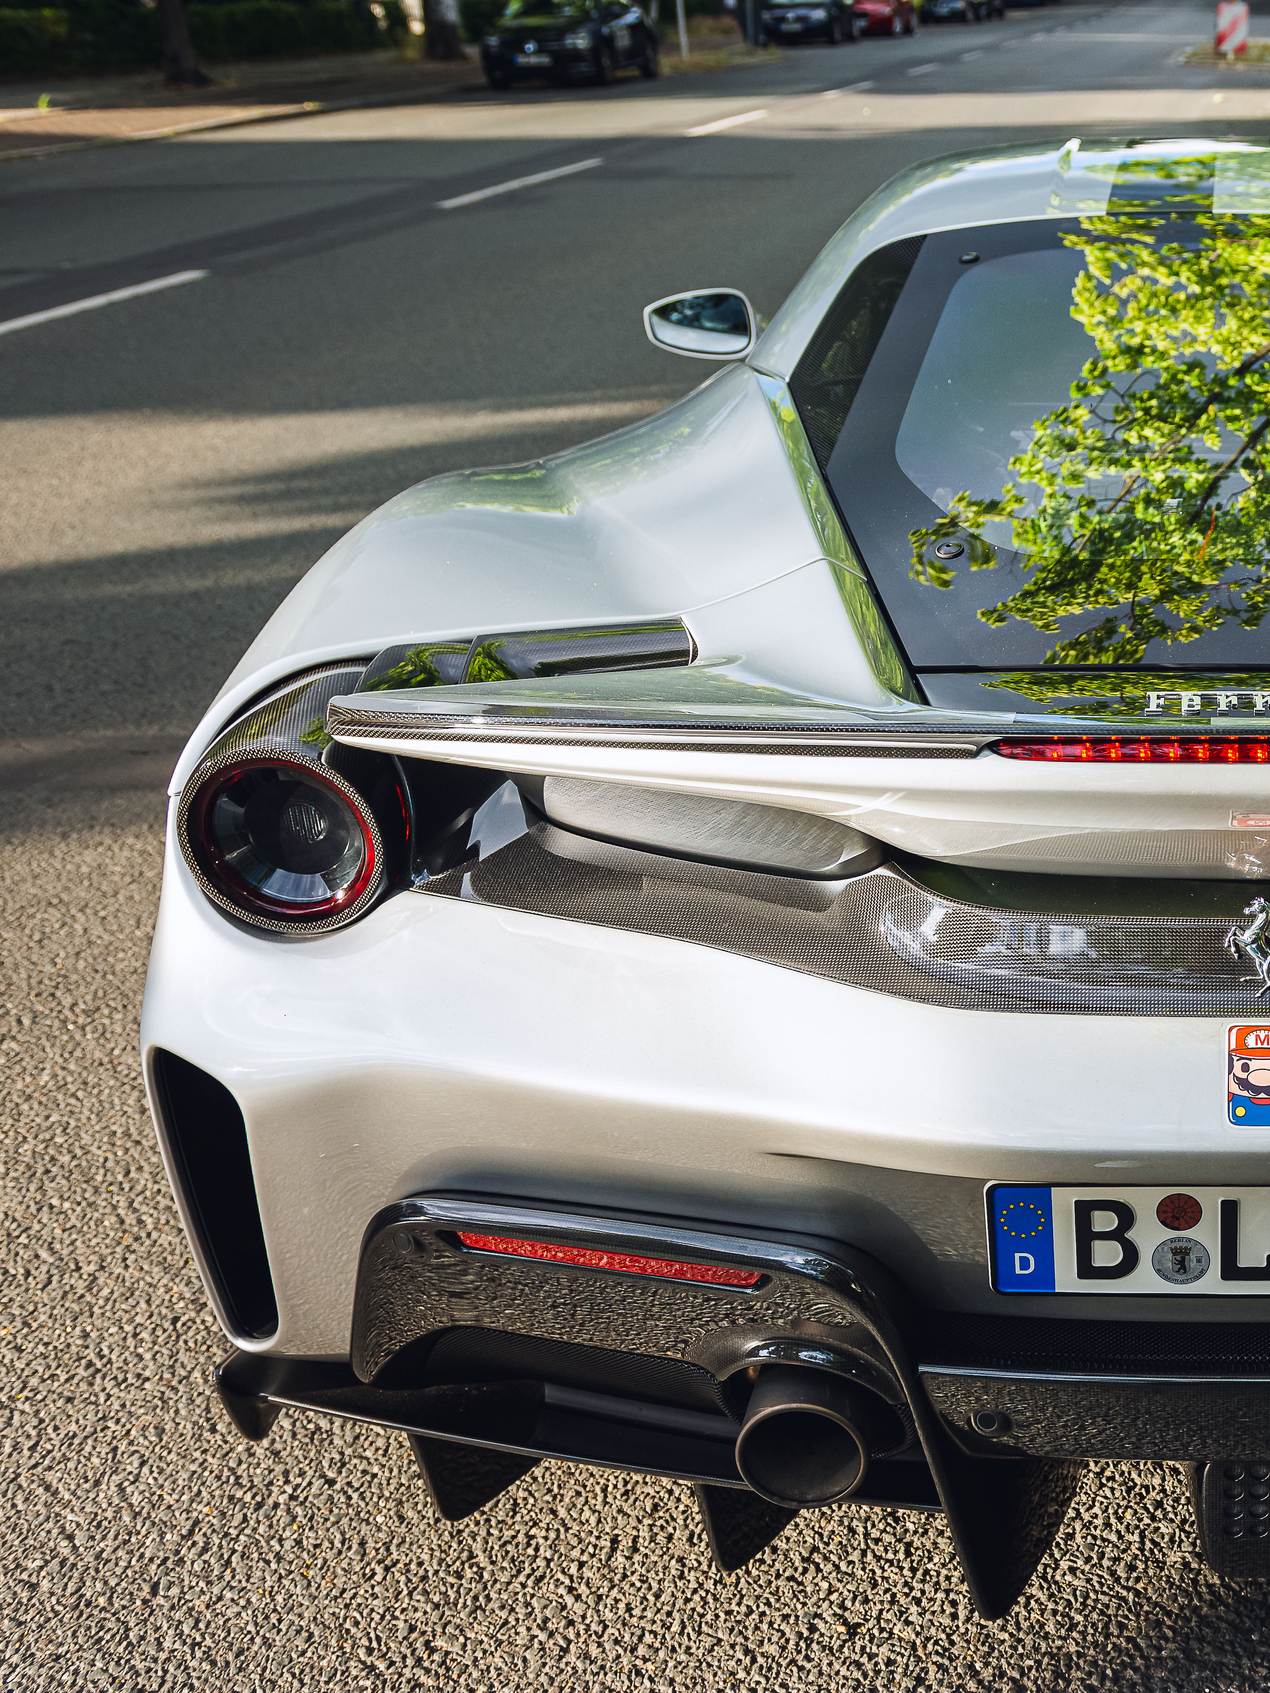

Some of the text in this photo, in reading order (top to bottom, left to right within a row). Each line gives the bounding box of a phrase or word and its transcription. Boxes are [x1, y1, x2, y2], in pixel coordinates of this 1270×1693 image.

[1255, 1034, 1270, 1046] M
[1073, 1199, 1138, 1280] B
[1014, 1252, 1035, 1275] D
